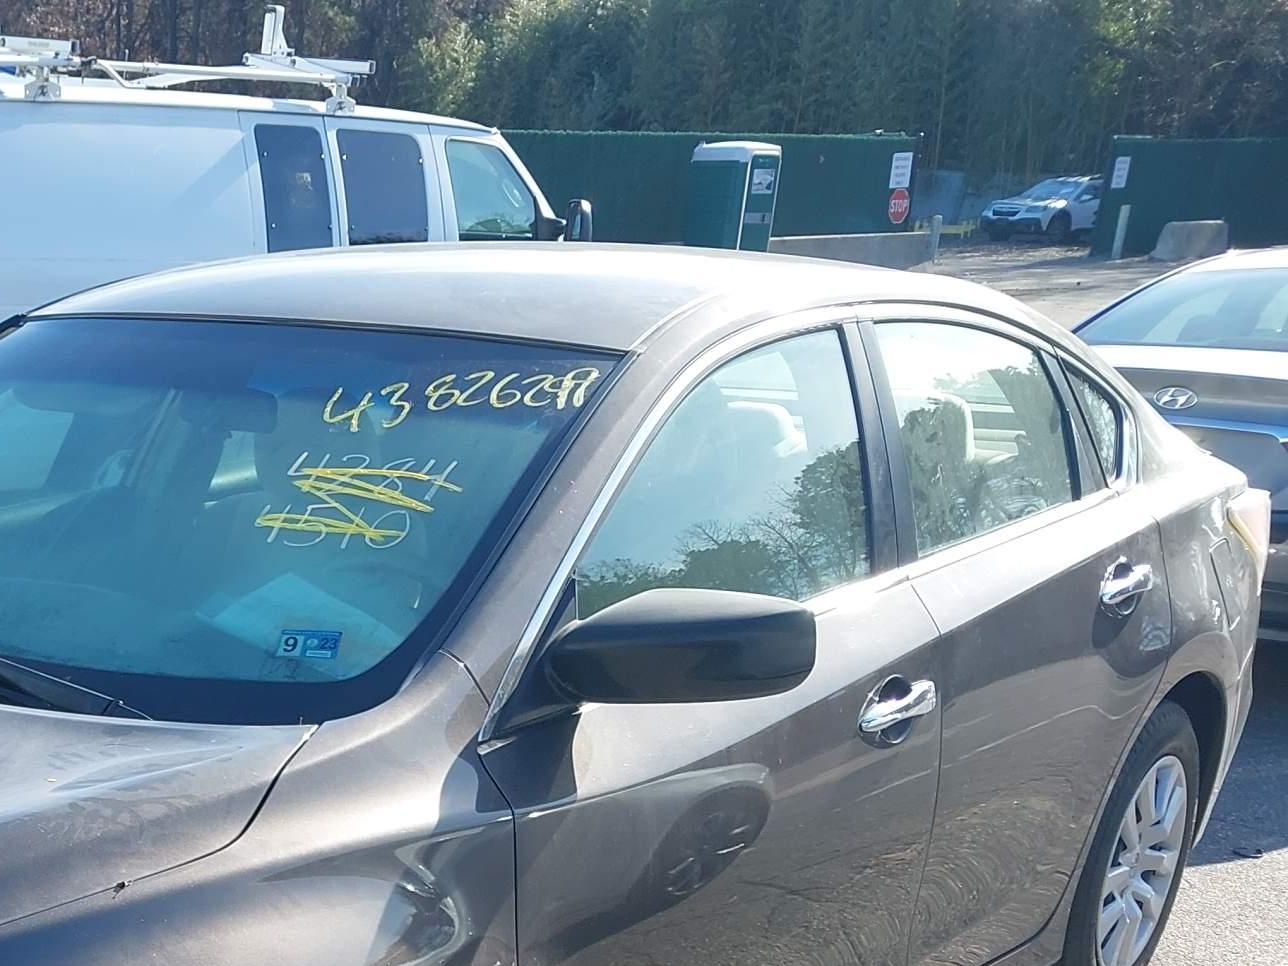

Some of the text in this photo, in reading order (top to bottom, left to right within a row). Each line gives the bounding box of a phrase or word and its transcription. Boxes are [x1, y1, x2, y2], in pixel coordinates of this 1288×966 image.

[890, 200, 908, 212] STOP
[283, 636, 337, 653] 9 23
